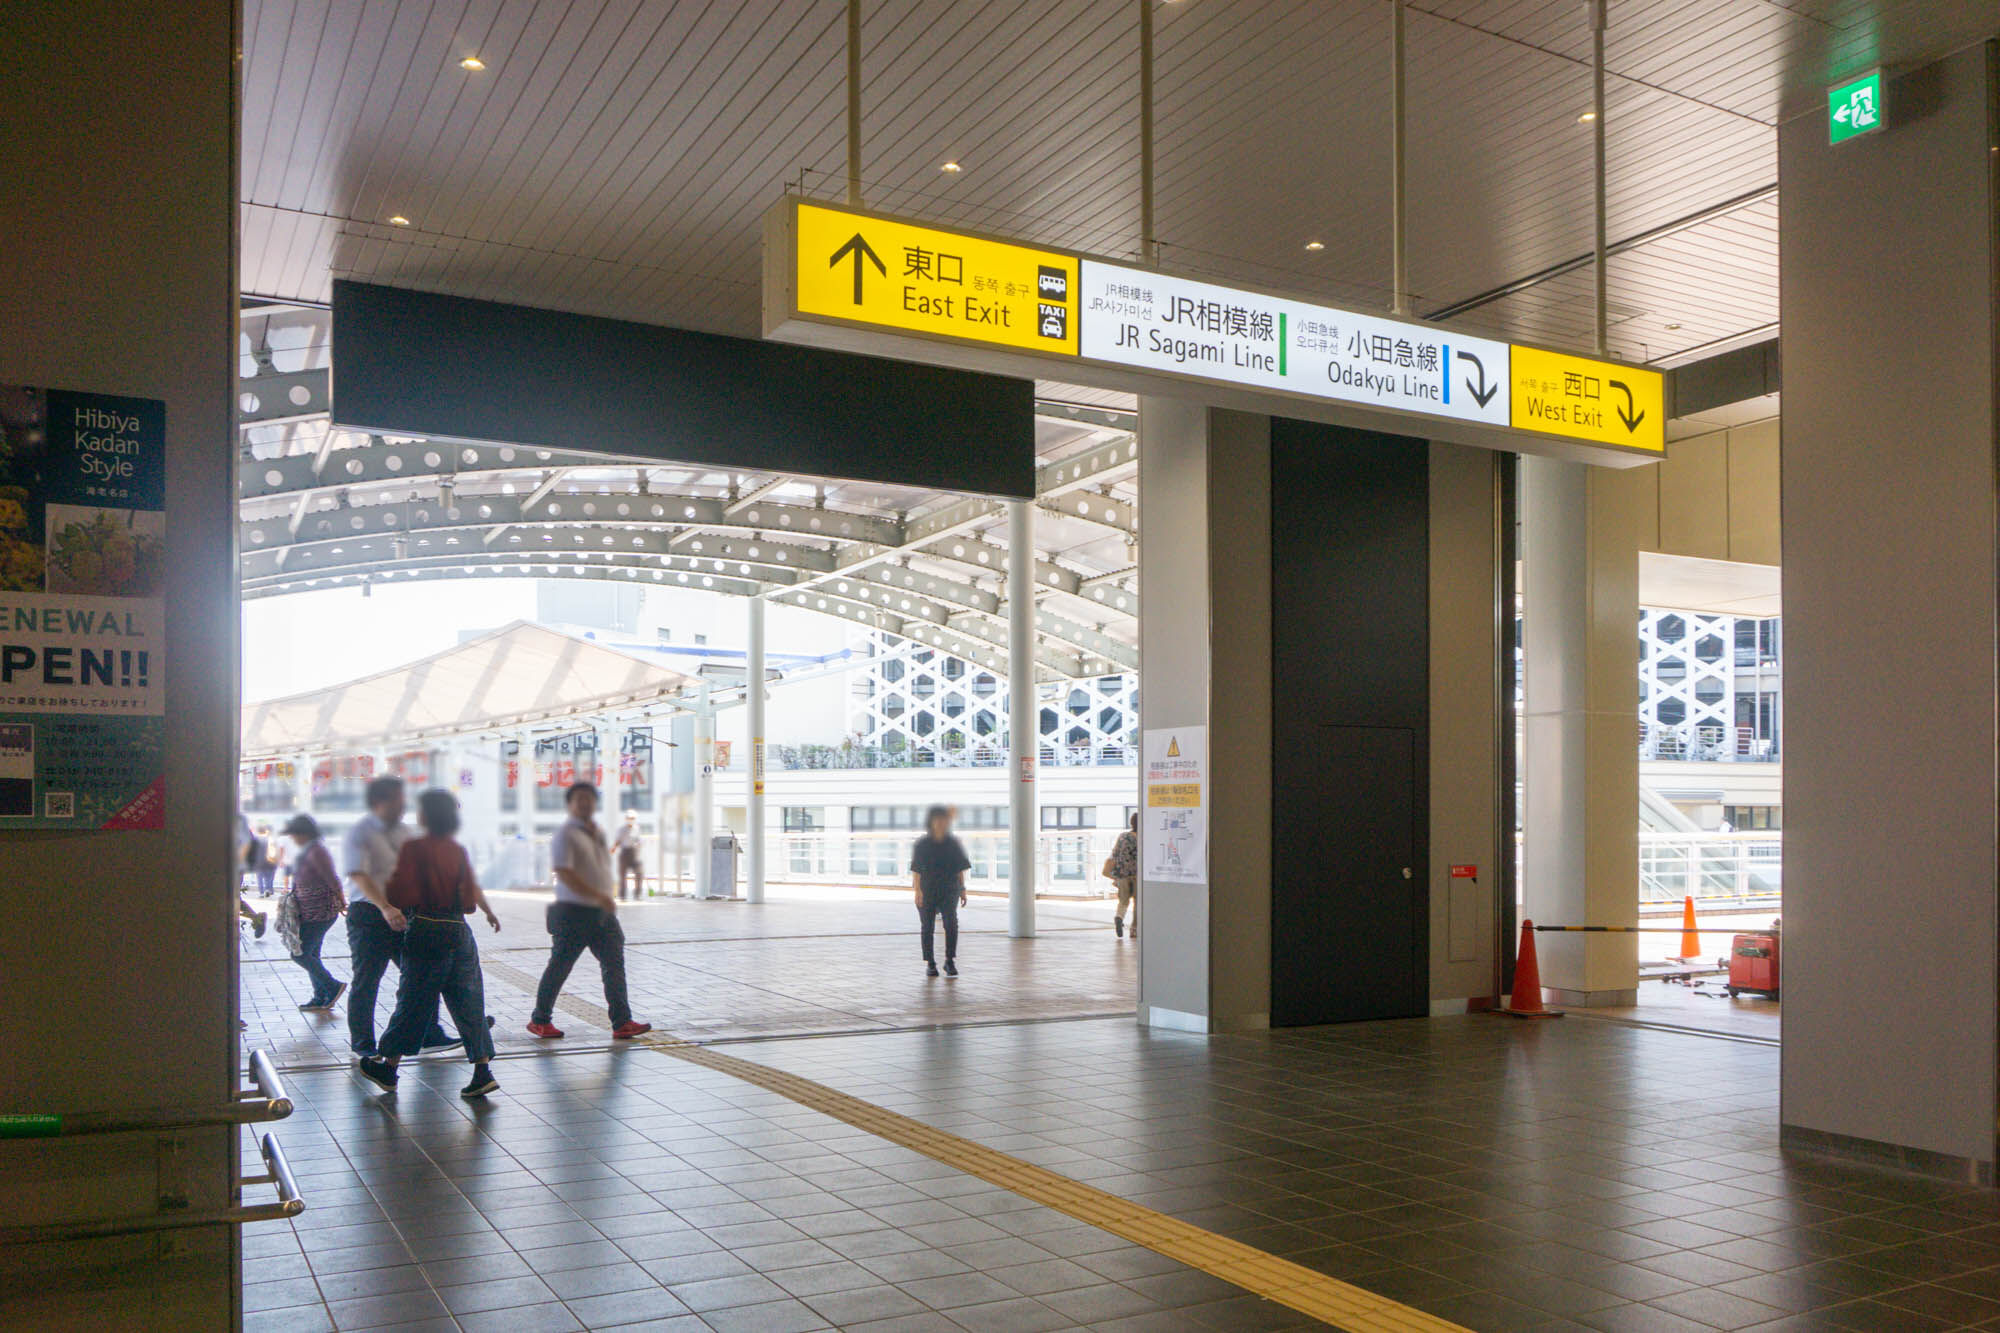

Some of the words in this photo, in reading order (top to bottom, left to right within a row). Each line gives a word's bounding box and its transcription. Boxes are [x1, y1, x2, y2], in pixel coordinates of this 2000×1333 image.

[903, 246, 963, 286] 東口
[972, 275, 999, 293] 동쪽
[1004, 282, 1030, 298] 출구
[903, 286, 954, 318] East
[965, 296, 1011, 328] Exit
[1039, 304, 1065, 318] TAXI
[1089, 297, 1152, 321] JR사가미선
[1161, 295, 1275, 342] JR相模線
[1115, 323, 1140, 348] JR
[1149, 329, 1225, 363] Sagami
[1234, 343, 1275, 372] Line
[1347, 330, 1439, 372] 小田急線
[1328, 361, 1395, 397] Odakyū
[1403, 374, 1439, 400] Line
[1563, 371, 1601, 401] 西口
[75, 407, 140, 434] Hibiya
[1527, 396, 1567, 422] West
[1573, 404, 1603, 428] Exit
[75, 430, 140, 455] Kadan
[80, 453, 134, 481] Style
[2, 645, 149, 687] PEN!!
